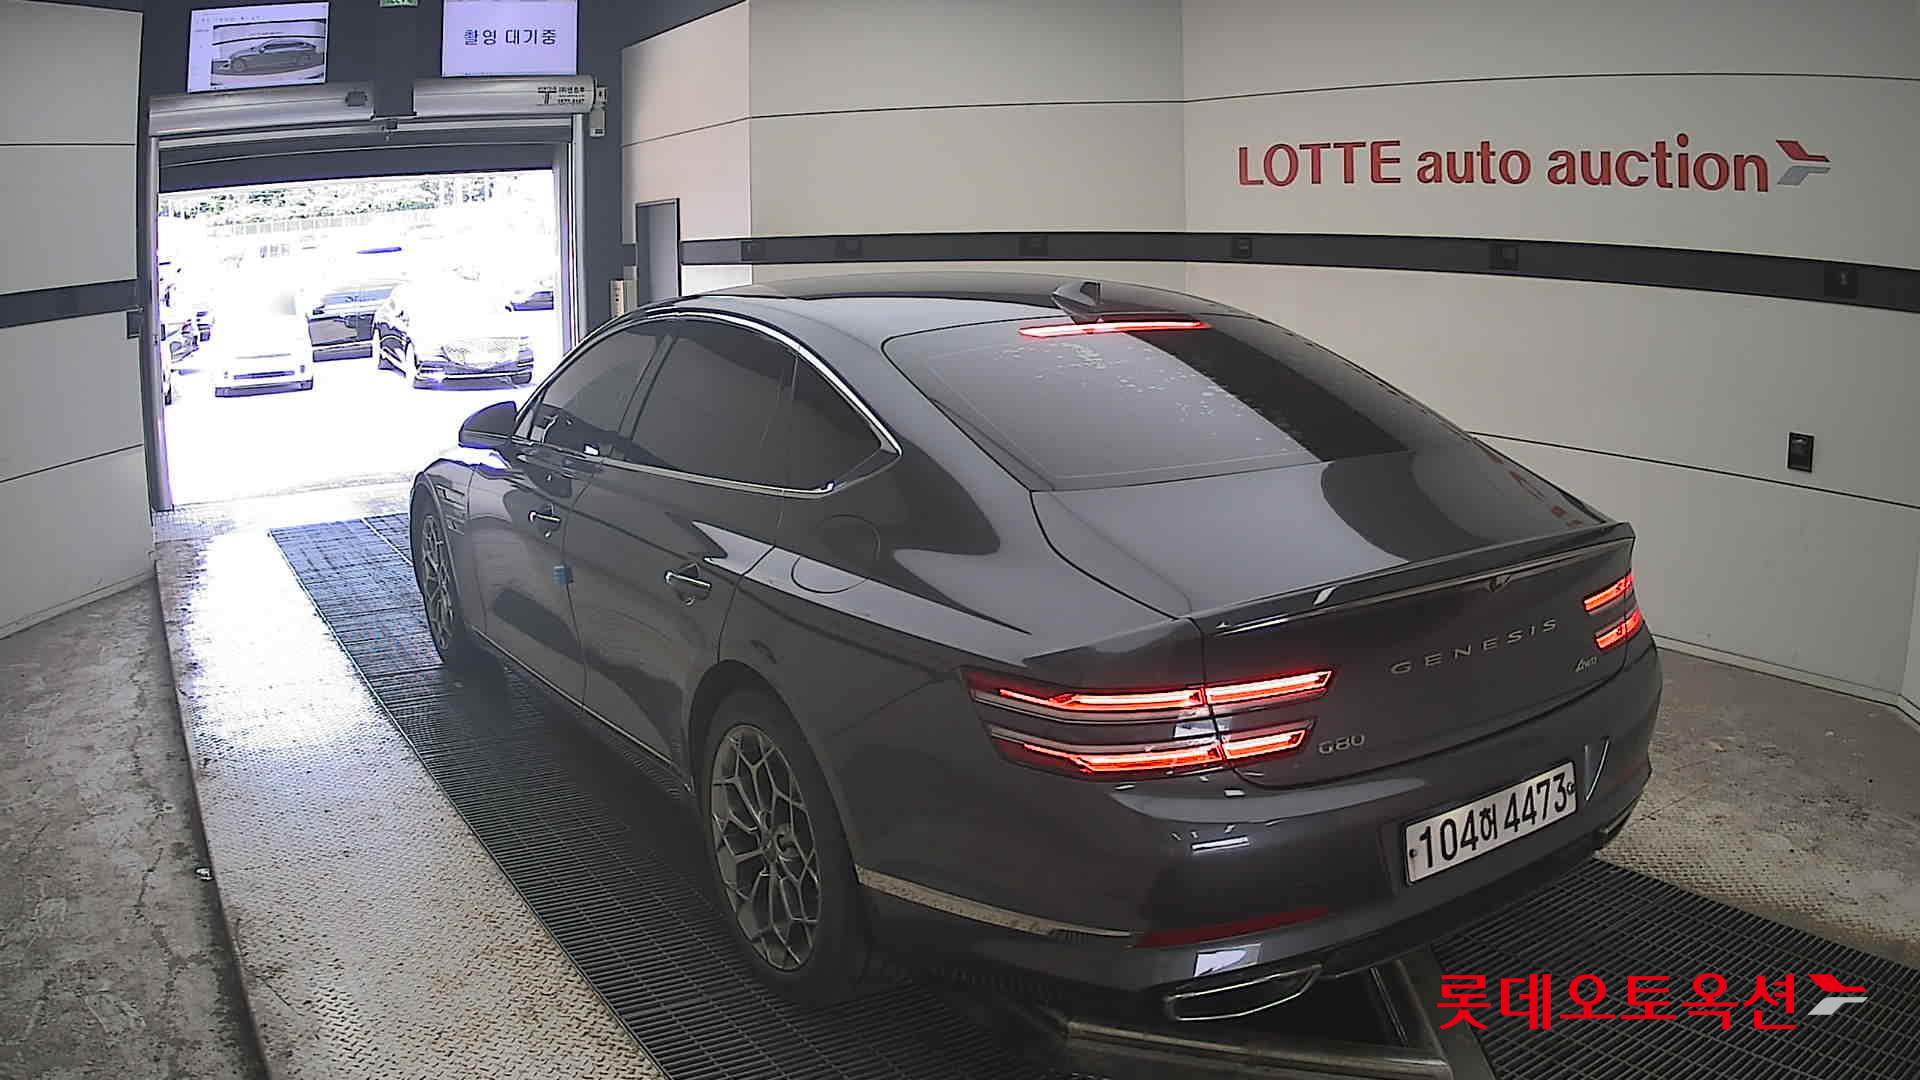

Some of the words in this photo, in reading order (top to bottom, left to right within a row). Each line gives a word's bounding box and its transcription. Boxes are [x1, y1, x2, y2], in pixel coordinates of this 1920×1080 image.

[505, 29, 557, 45] 대기중
[1240, 141, 1401, 187] LOTTE
[1417, 142, 1532, 183] auto
[1549, 133, 1768, 193] auction
[1391, 618, 1557, 674] GENESIS
[1318, 733, 1366, 754] G80
[1419, 803, 1499, 868] 104허
[1503, 772, 1567, 832] 4473
